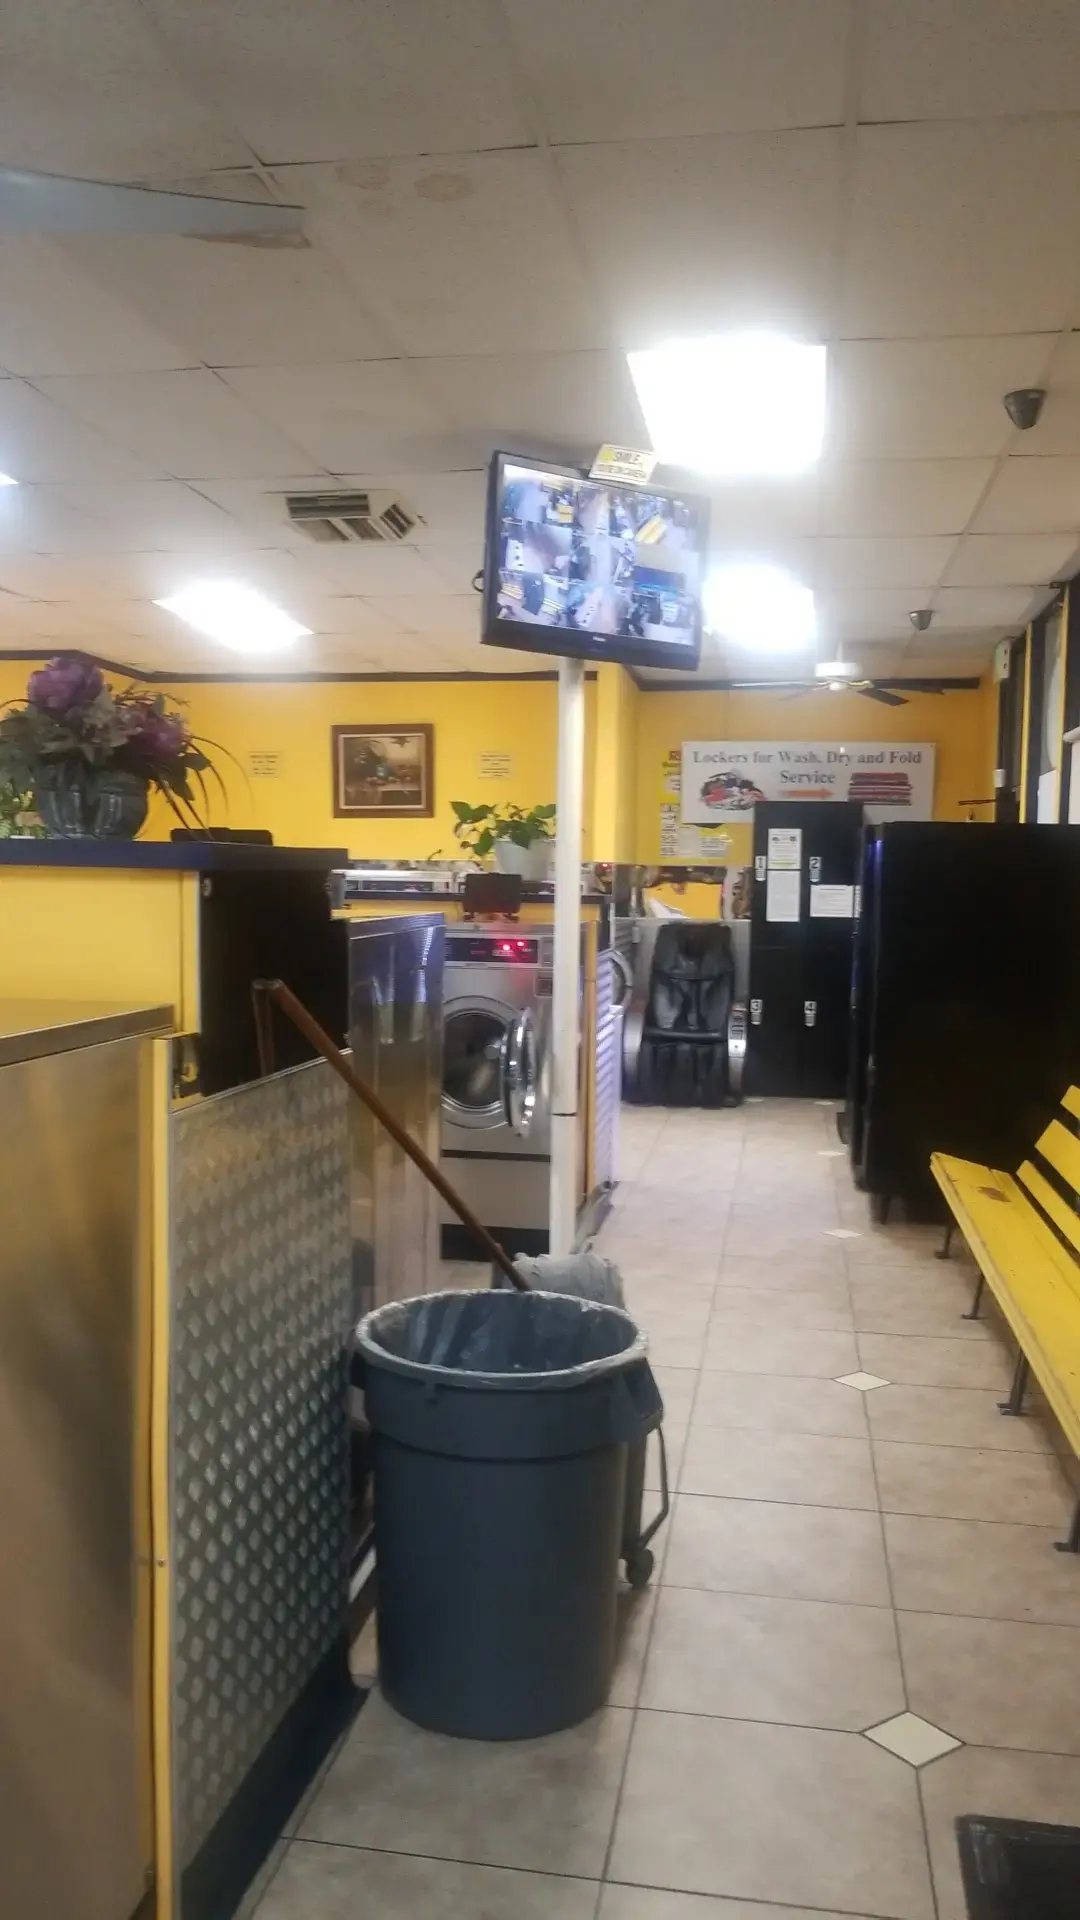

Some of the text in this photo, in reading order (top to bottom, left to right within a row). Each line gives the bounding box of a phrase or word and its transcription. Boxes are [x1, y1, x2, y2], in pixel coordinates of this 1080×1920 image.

[693, 751, 747, 763] Lockers
[753, 751, 774, 763] for
[827, 751, 850, 767] Dry
[857, 751, 885, 763] and
[890, 751, 922, 764] Fold
[780, 770, 836, 784] Service
[811, 858, 820, 869] 2
[751, 1000, 759, 1011] 3
[806, 1002, 814, 1012] 4
